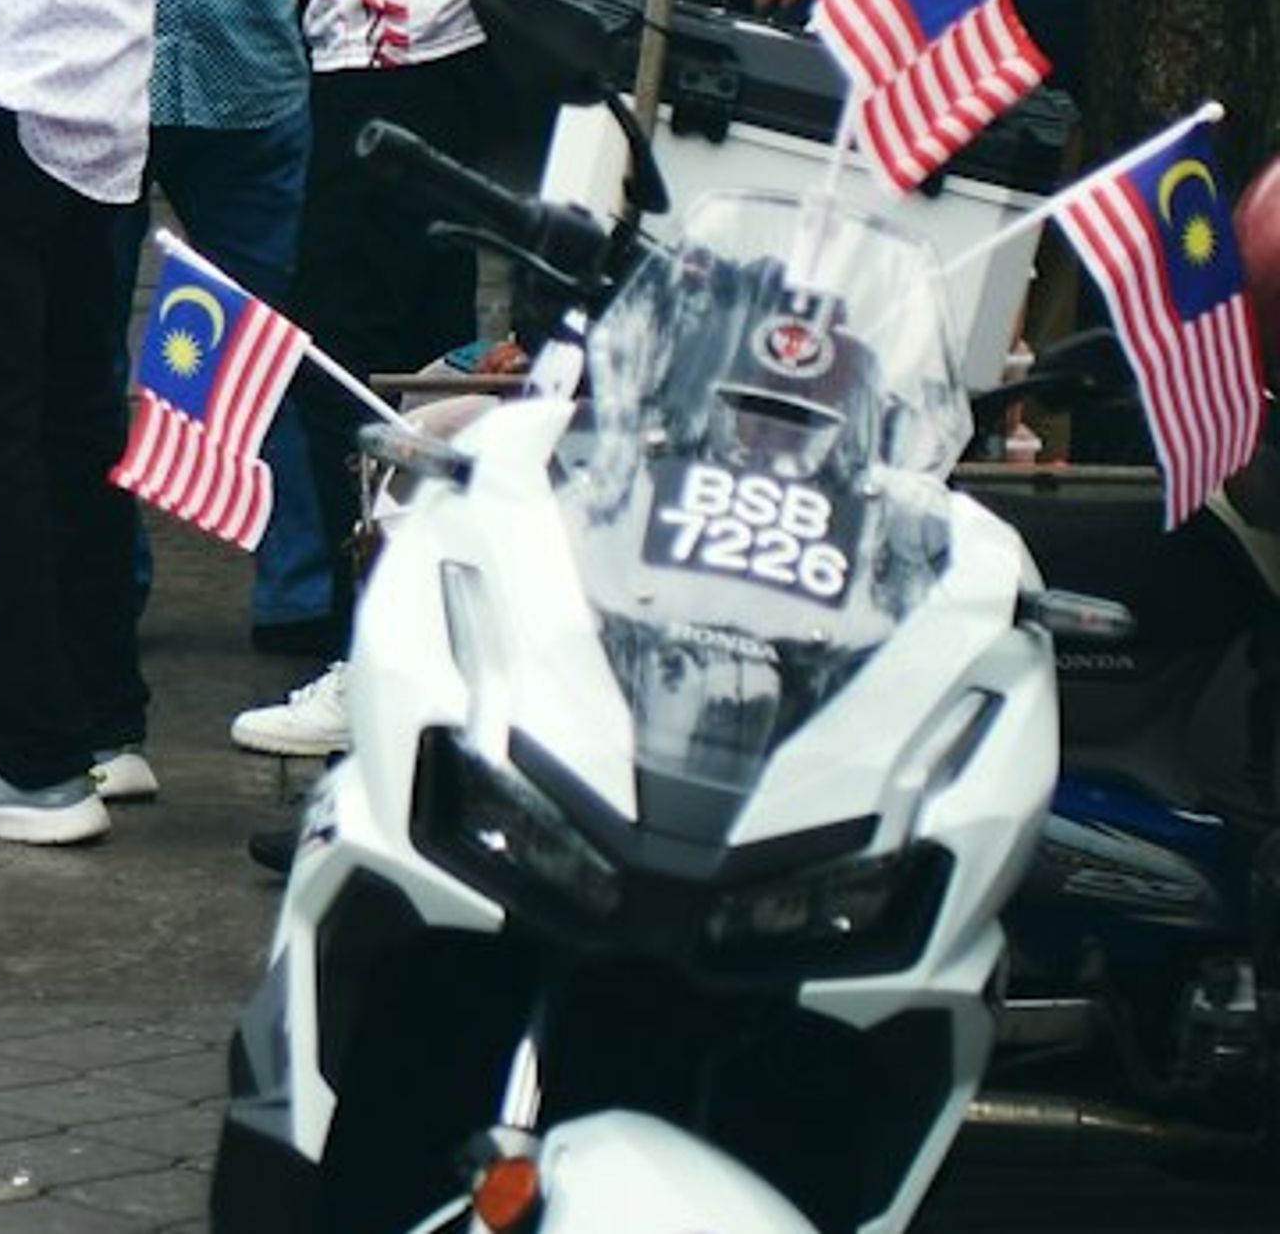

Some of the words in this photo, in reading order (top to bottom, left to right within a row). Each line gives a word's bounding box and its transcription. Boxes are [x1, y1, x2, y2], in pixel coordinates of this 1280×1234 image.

[682, 464, 832, 541] BSB
[659, 507, 850, 598] 7226
[1057, 653, 1136, 671] ONDA
